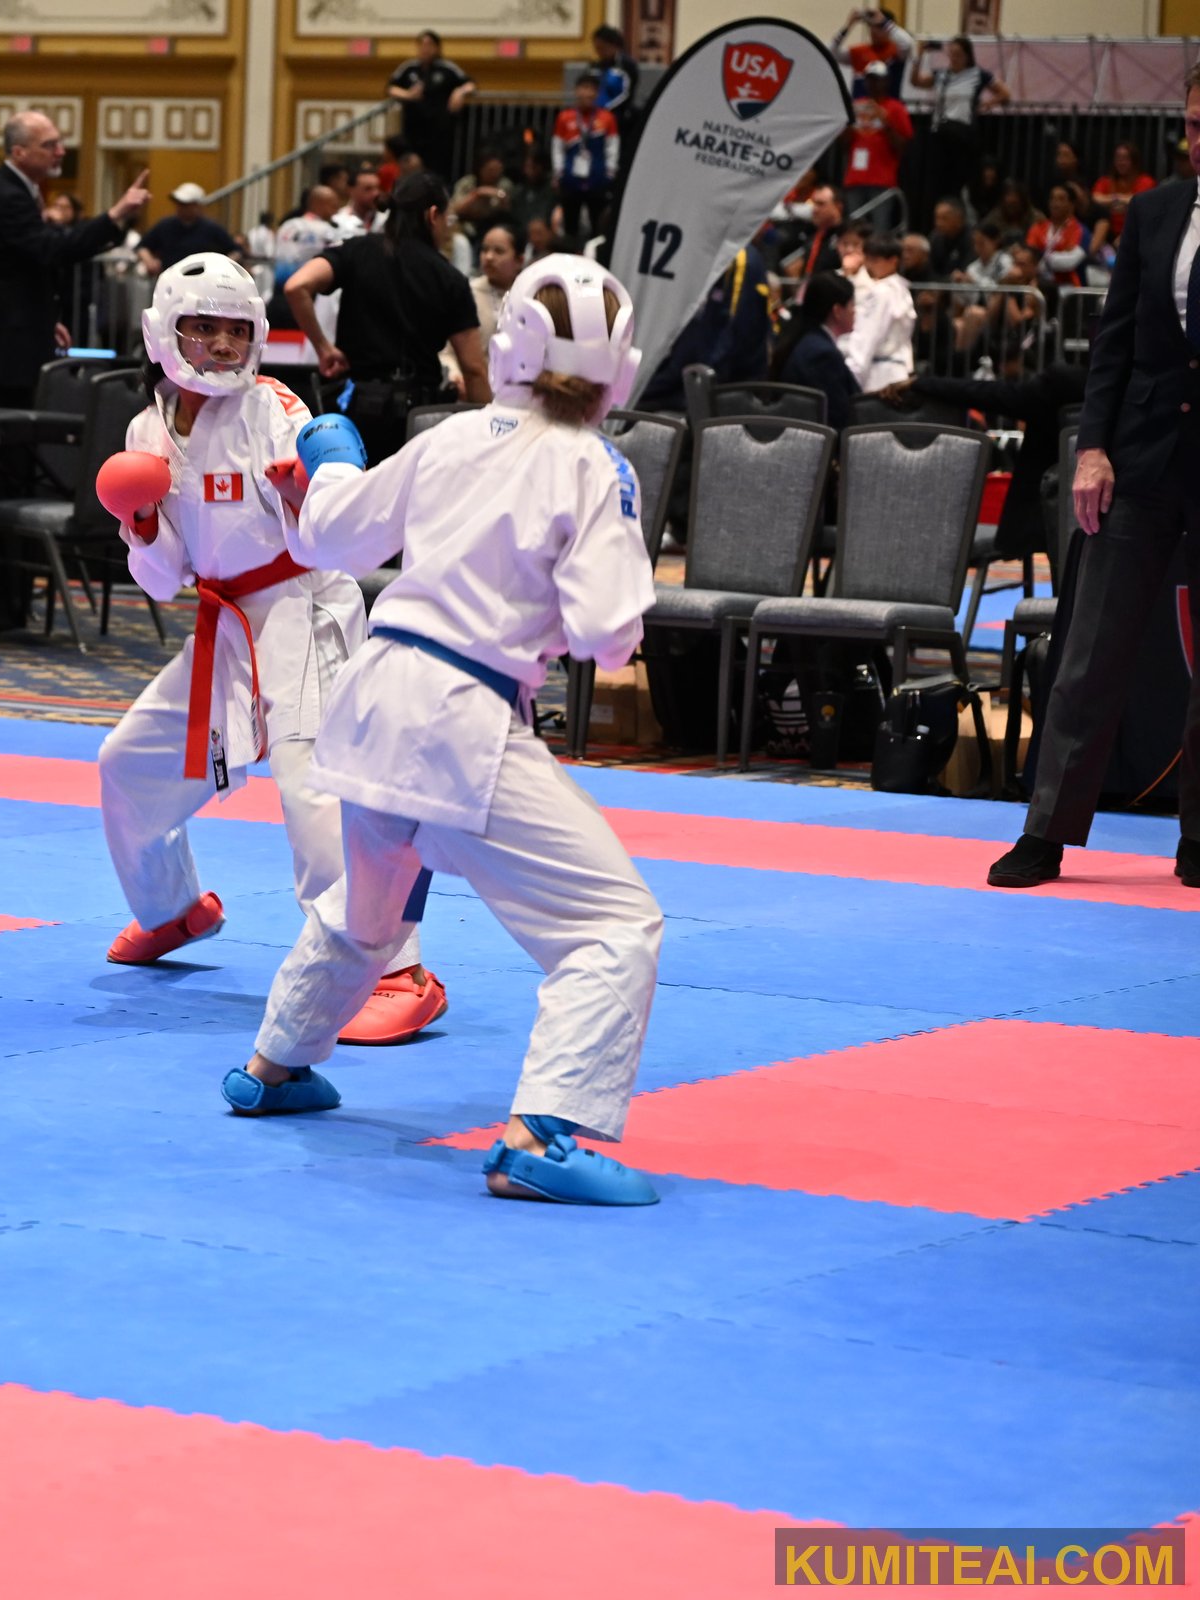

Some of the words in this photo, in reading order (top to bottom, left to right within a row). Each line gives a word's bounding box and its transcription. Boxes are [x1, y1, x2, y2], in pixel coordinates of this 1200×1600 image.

[730, 50, 779, 82] USA
[675, 126, 793, 171] KARATE-DO
[703, 121, 771, 147] NATIONAL
[695, 152, 765, 177] FEDERATION
[638, 219, 683, 280] 12
